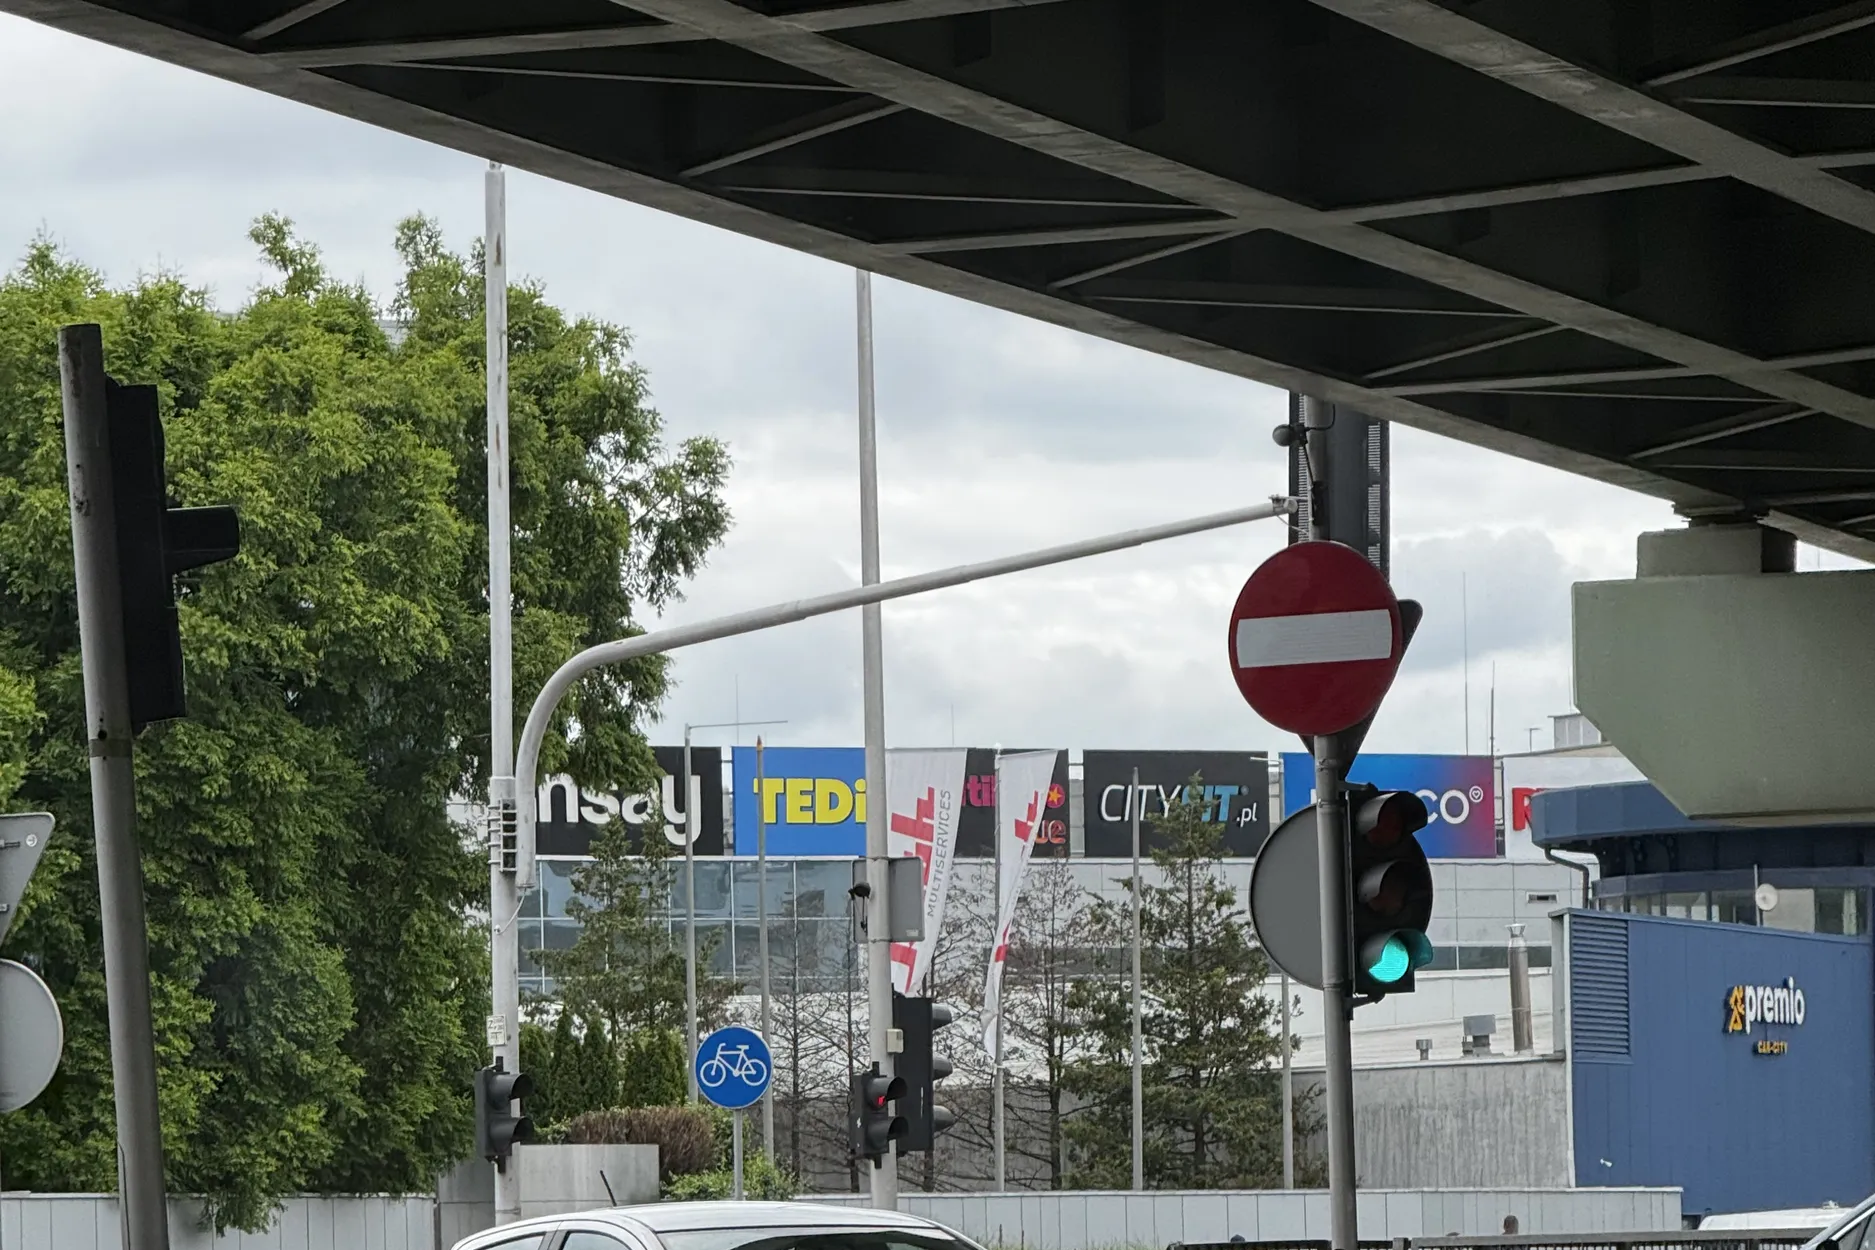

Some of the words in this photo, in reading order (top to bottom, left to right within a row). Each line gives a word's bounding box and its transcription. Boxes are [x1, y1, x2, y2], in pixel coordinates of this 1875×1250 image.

[536, 773, 702, 846] nsay
[753, 778, 867, 825] TEDi
[927, 789, 951, 917] MULTISERVICES
[1745, 976, 1804, 1034] premio
